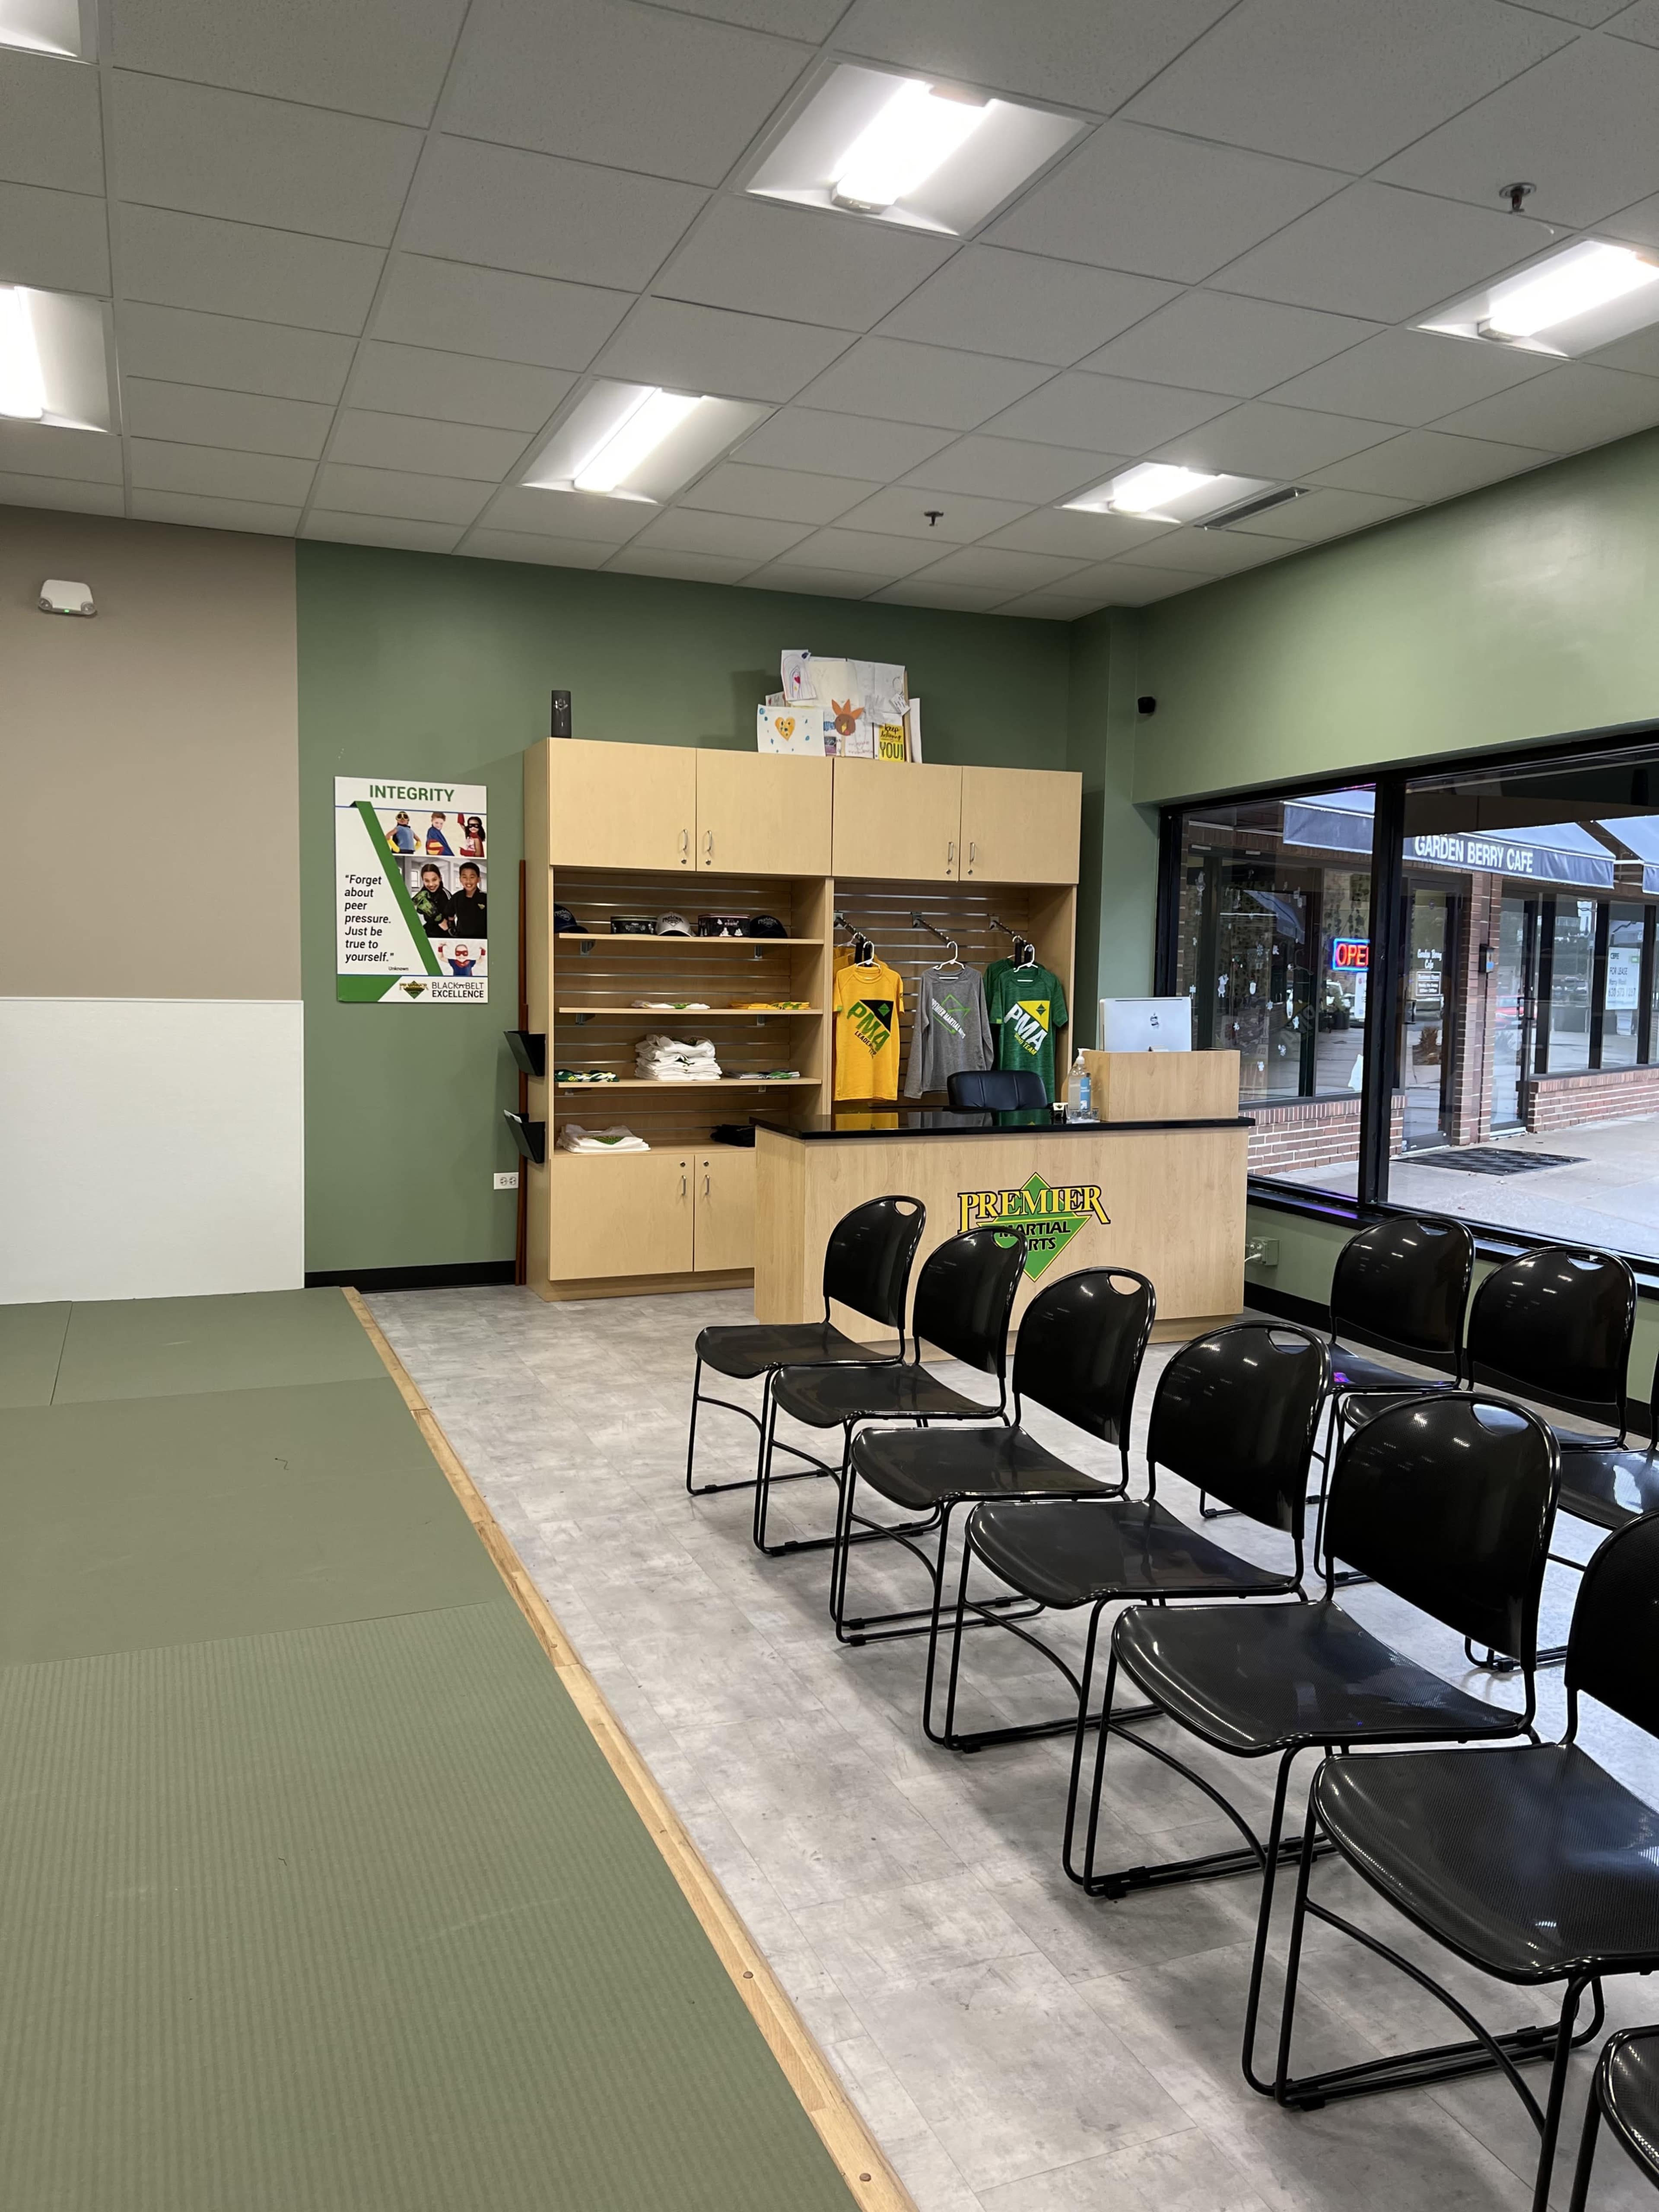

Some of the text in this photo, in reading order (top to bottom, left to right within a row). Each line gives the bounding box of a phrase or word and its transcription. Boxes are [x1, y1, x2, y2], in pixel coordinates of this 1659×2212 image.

[880, 742, 903, 760] YOU!
[369, 785, 455, 802] INTEGRITY
[1414, 836, 1533, 873] GARDEN BERRY CAFE
[345, 874, 382, 887] "Forget
[344, 887, 374, 897] about
[344, 902, 367, 912] peer
[345, 915, 391, 925] pressure.
[345, 926, 382, 936] Just be
[346, 940, 378, 949] true to
[345, 952, 394, 963] yourself."
[1336, 944, 1369, 966] OPE
[846, 1001, 890, 1052] PMA
[943, 1012, 960, 1031] MARTIAL
[1003, 1003, 1048, 1052] PMA
[1023, 1042, 1037, 1055] TEAM
[957, 1185, 1111, 1234] PREMIER
[1027, 1236, 1057, 1252] RTS
